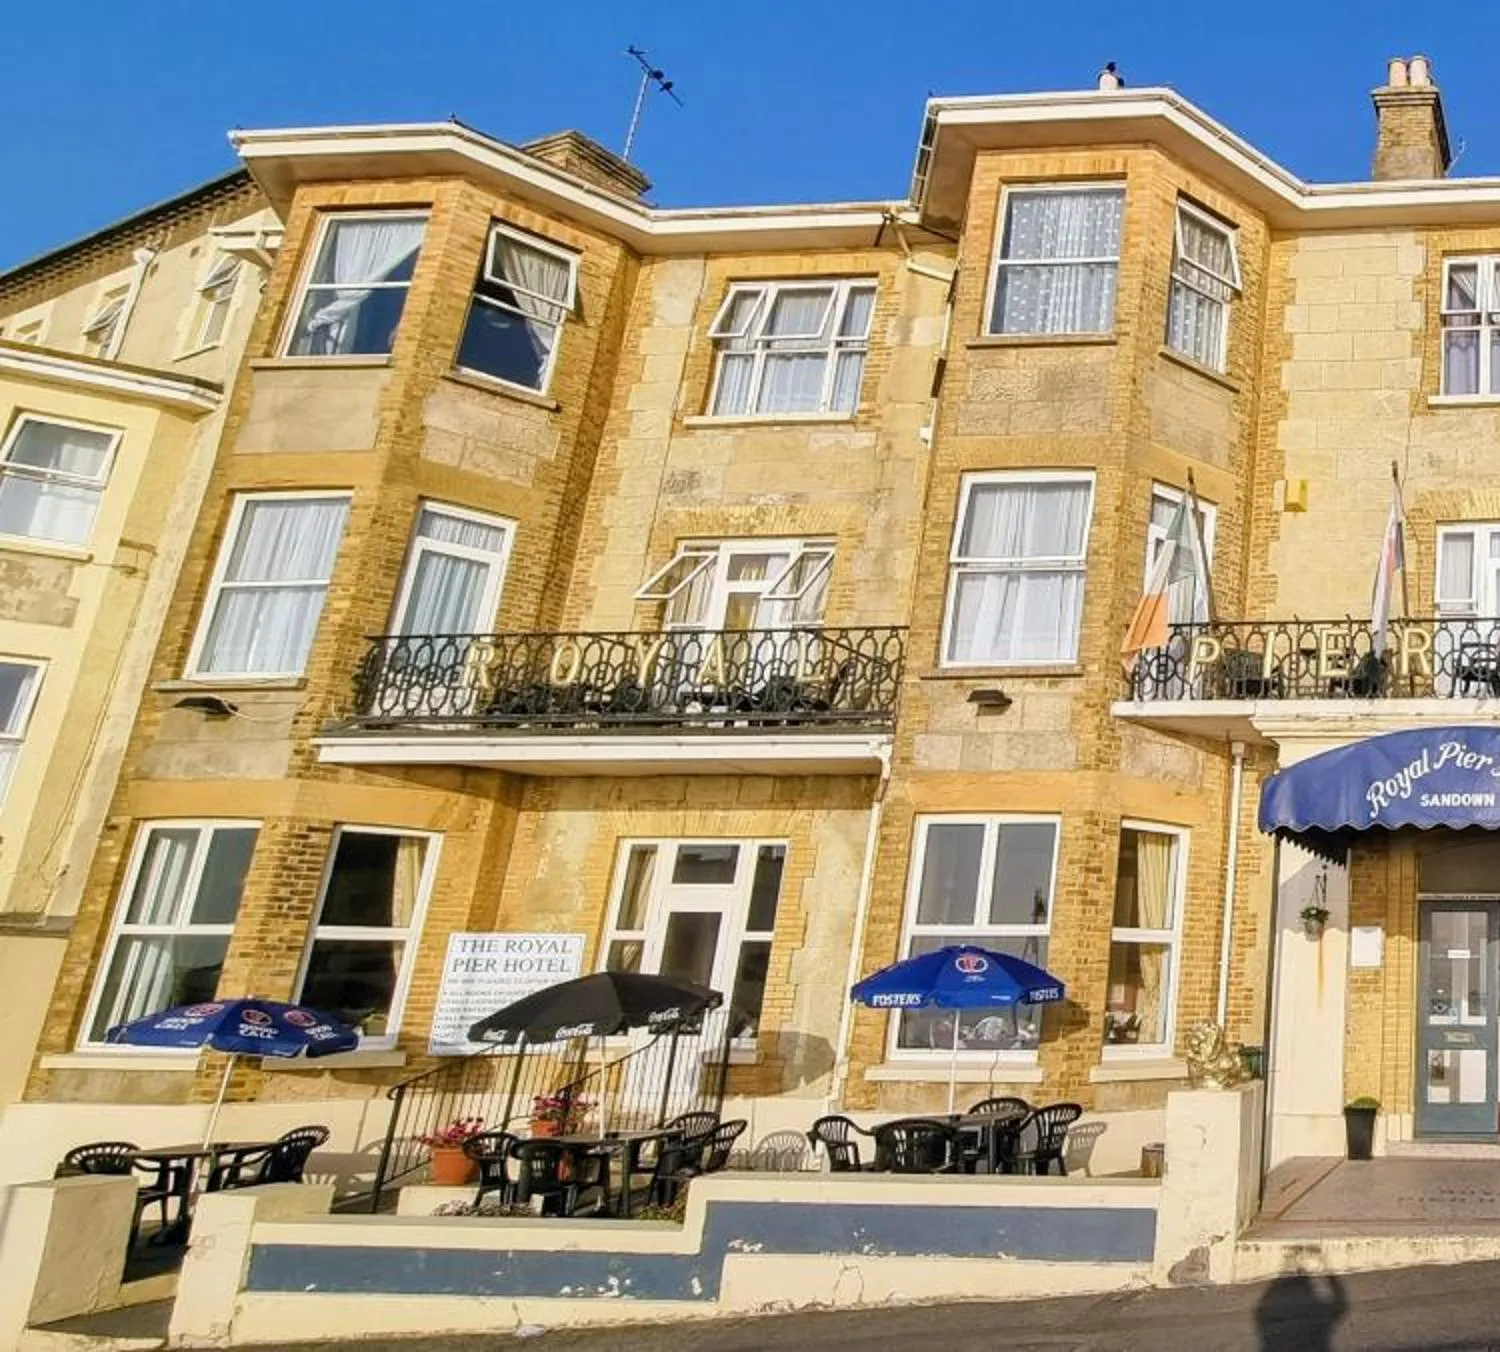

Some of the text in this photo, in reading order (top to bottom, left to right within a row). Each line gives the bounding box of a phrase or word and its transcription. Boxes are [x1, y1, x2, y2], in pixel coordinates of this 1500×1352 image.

[460, 636, 828, 690] ROYAL
[1187, 626, 1432, 684] PIER
[1366, 748, 1431, 819] Royal
[1433, 741, 1493, 771] Pier
[1420, 793, 1496, 808] SANDOWN
[458, 938, 574, 954] THE ROYAL
[452, 957, 573, 973] PIER HOTEL
